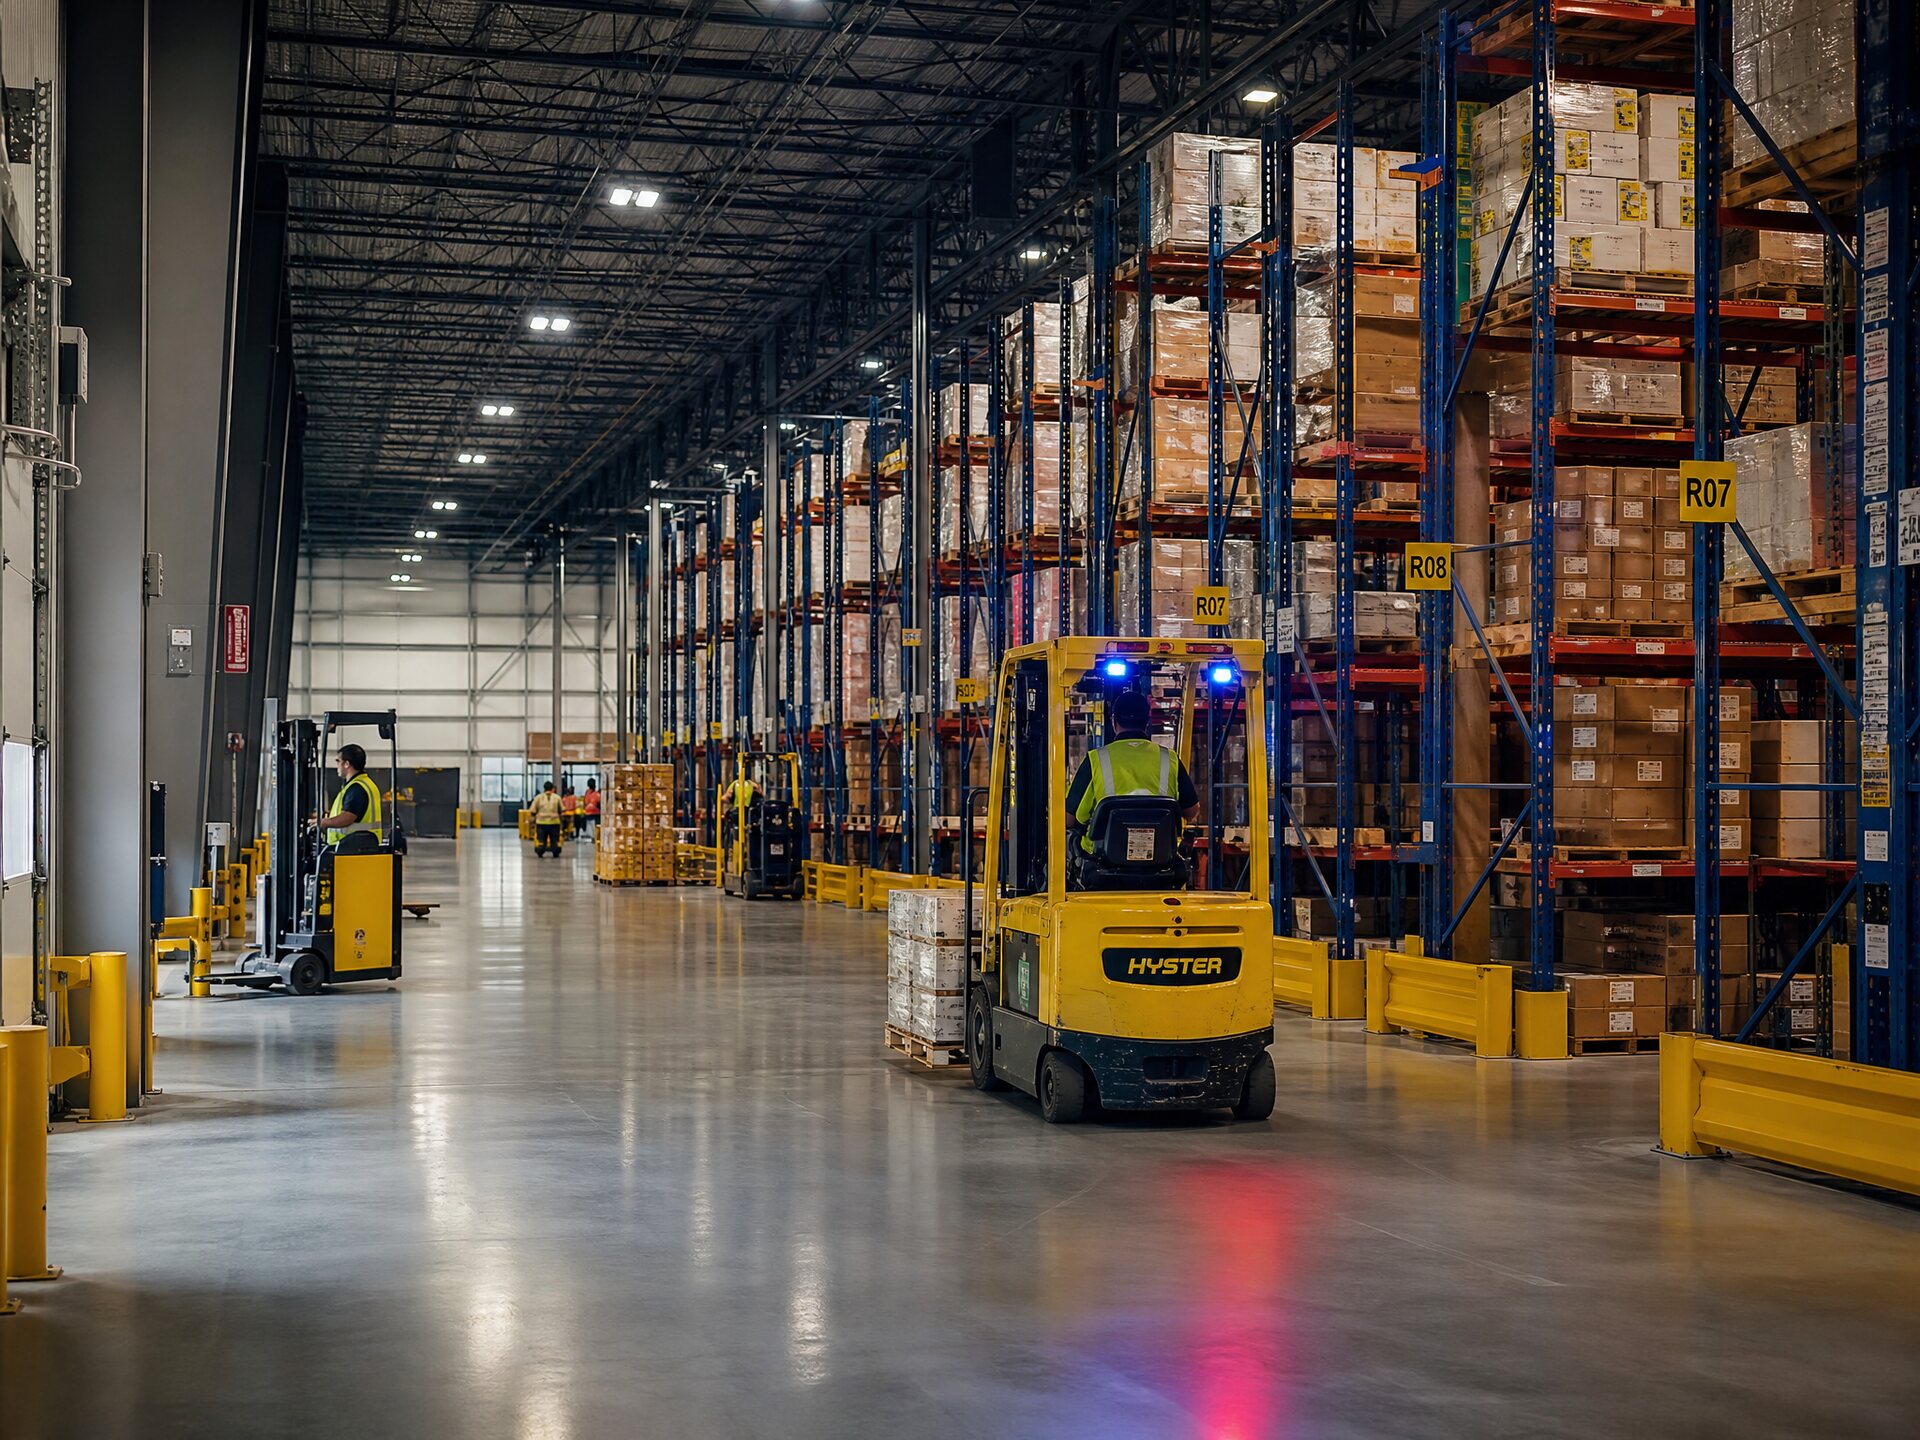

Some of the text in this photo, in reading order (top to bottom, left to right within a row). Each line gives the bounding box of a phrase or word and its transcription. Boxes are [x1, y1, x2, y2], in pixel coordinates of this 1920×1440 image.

[1686, 477, 1732, 508] R07
[1410, 555, 1447, 579] R08
[1196, 596, 1226, 616] R07
[1127, 957, 1223, 975] HYSTER
